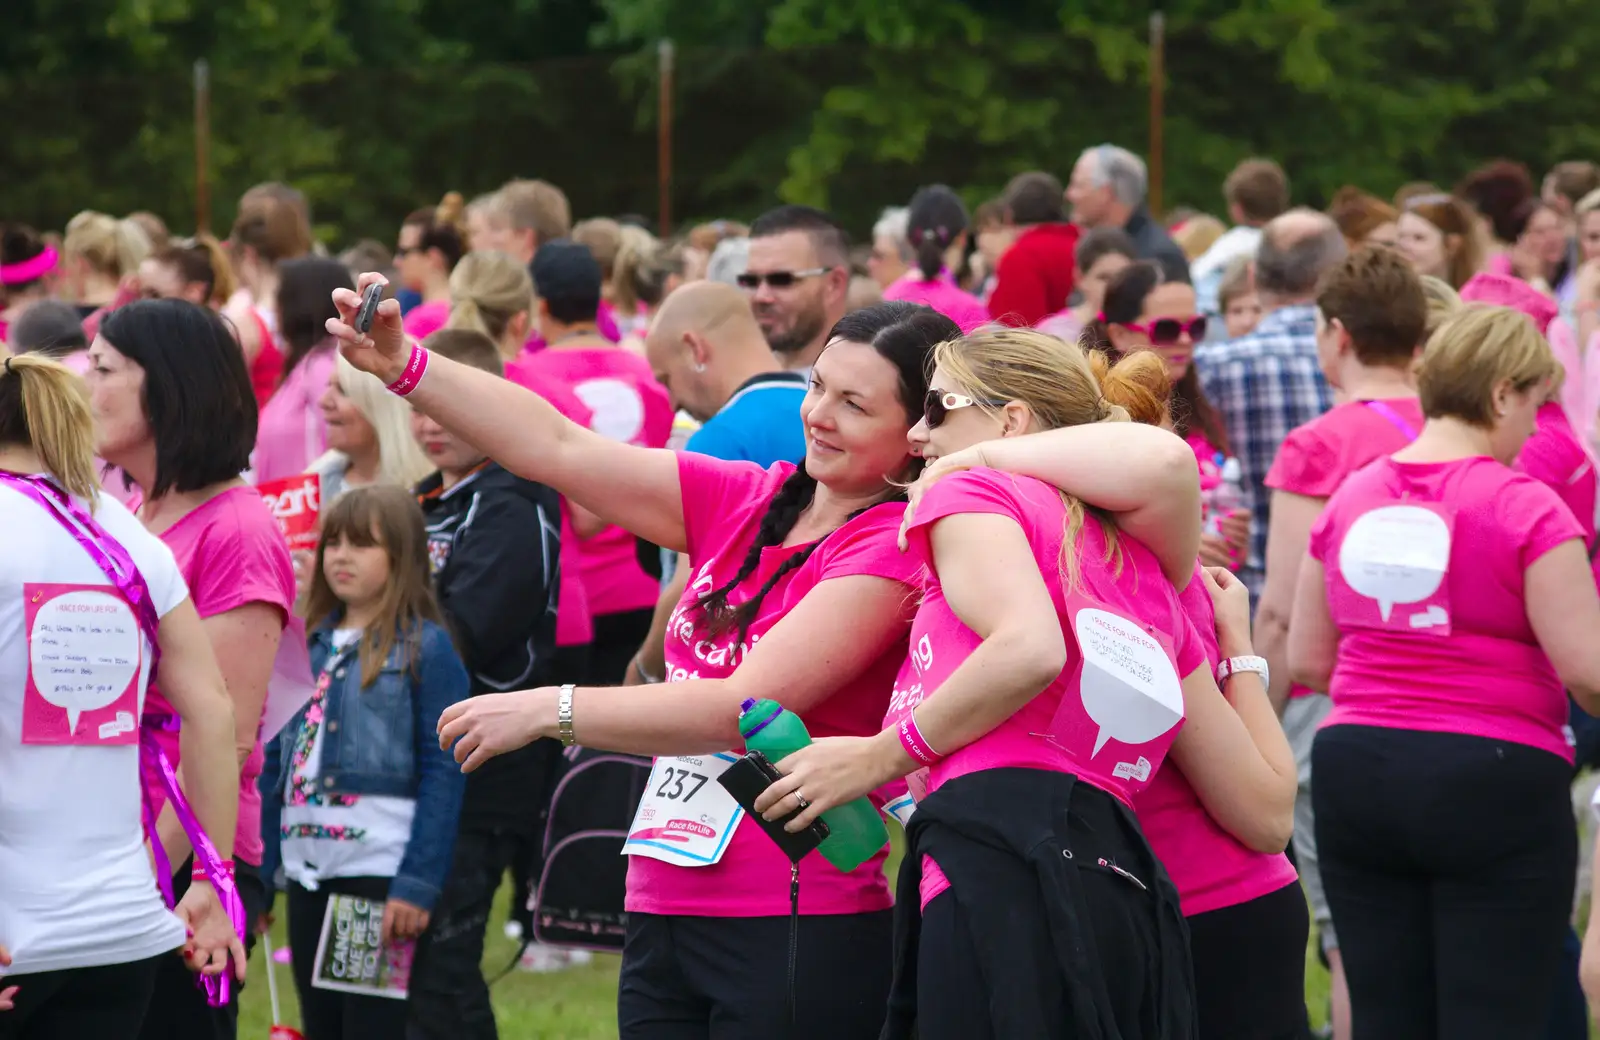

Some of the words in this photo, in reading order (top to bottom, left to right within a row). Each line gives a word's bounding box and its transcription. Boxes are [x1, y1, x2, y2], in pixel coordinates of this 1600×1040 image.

[411, 349, 422, 373] cancer
[396, 378, 410, 389] Jog
[59, 604, 76, 613] RACE
[77, 604, 90, 613] FOR
[91, 604, 103, 614] LIFE
[104, 605, 118, 614] FOR
[1094, 616, 1112, 632] RACE
[1113, 626, 1126, 636] FOR
[1127, 632, 1141, 645] LIFE
[1141, 639, 1156, 652] FOR
[901, 719, 909, 735] Jog
[906, 734, 914, 745] on
[1118, 764, 1128, 772] Race
[656, 767, 709, 803] 237
[668, 821, 687, 831] Race
[687, 822, 697, 833] for
[697, 824, 711, 836] Life
[332, 895, 354, 978] CANCER
[361, 955, 377, 980] TO
